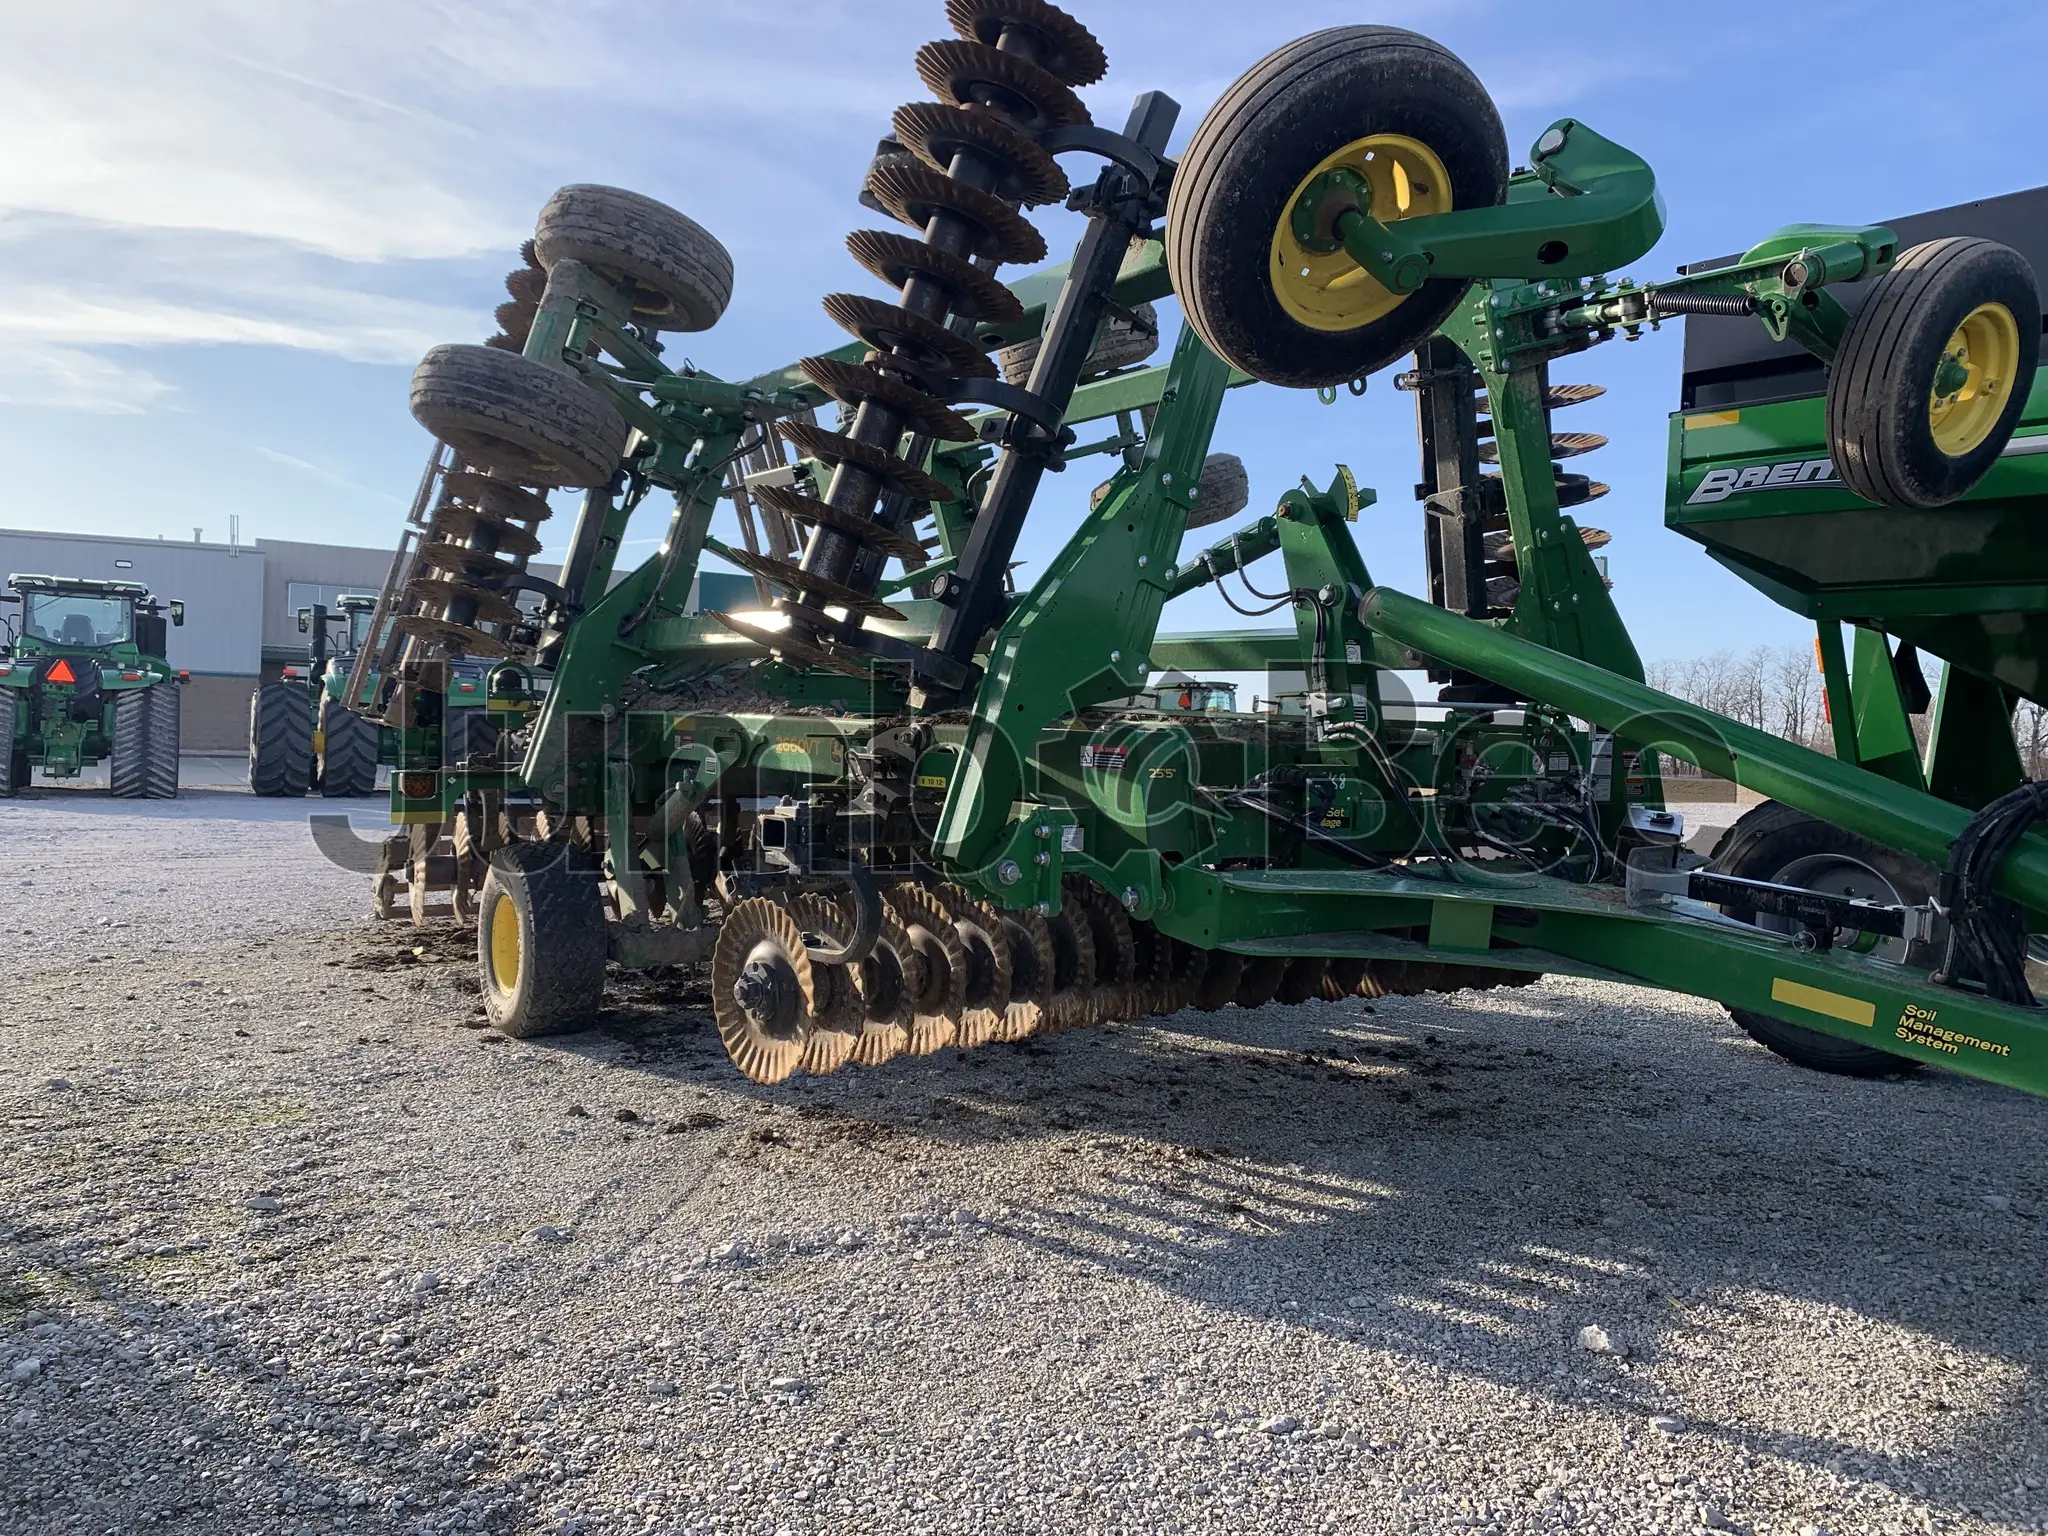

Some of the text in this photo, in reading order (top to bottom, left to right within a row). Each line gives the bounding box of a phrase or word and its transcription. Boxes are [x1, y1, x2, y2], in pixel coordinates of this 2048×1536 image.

[1685, 458, 1840, 505] BREN
[1904, 1004, 1938, 1022] Soil
[1894, 1027, 1959, 1055] System
[1898, 1015, 2011, 1057] Management
